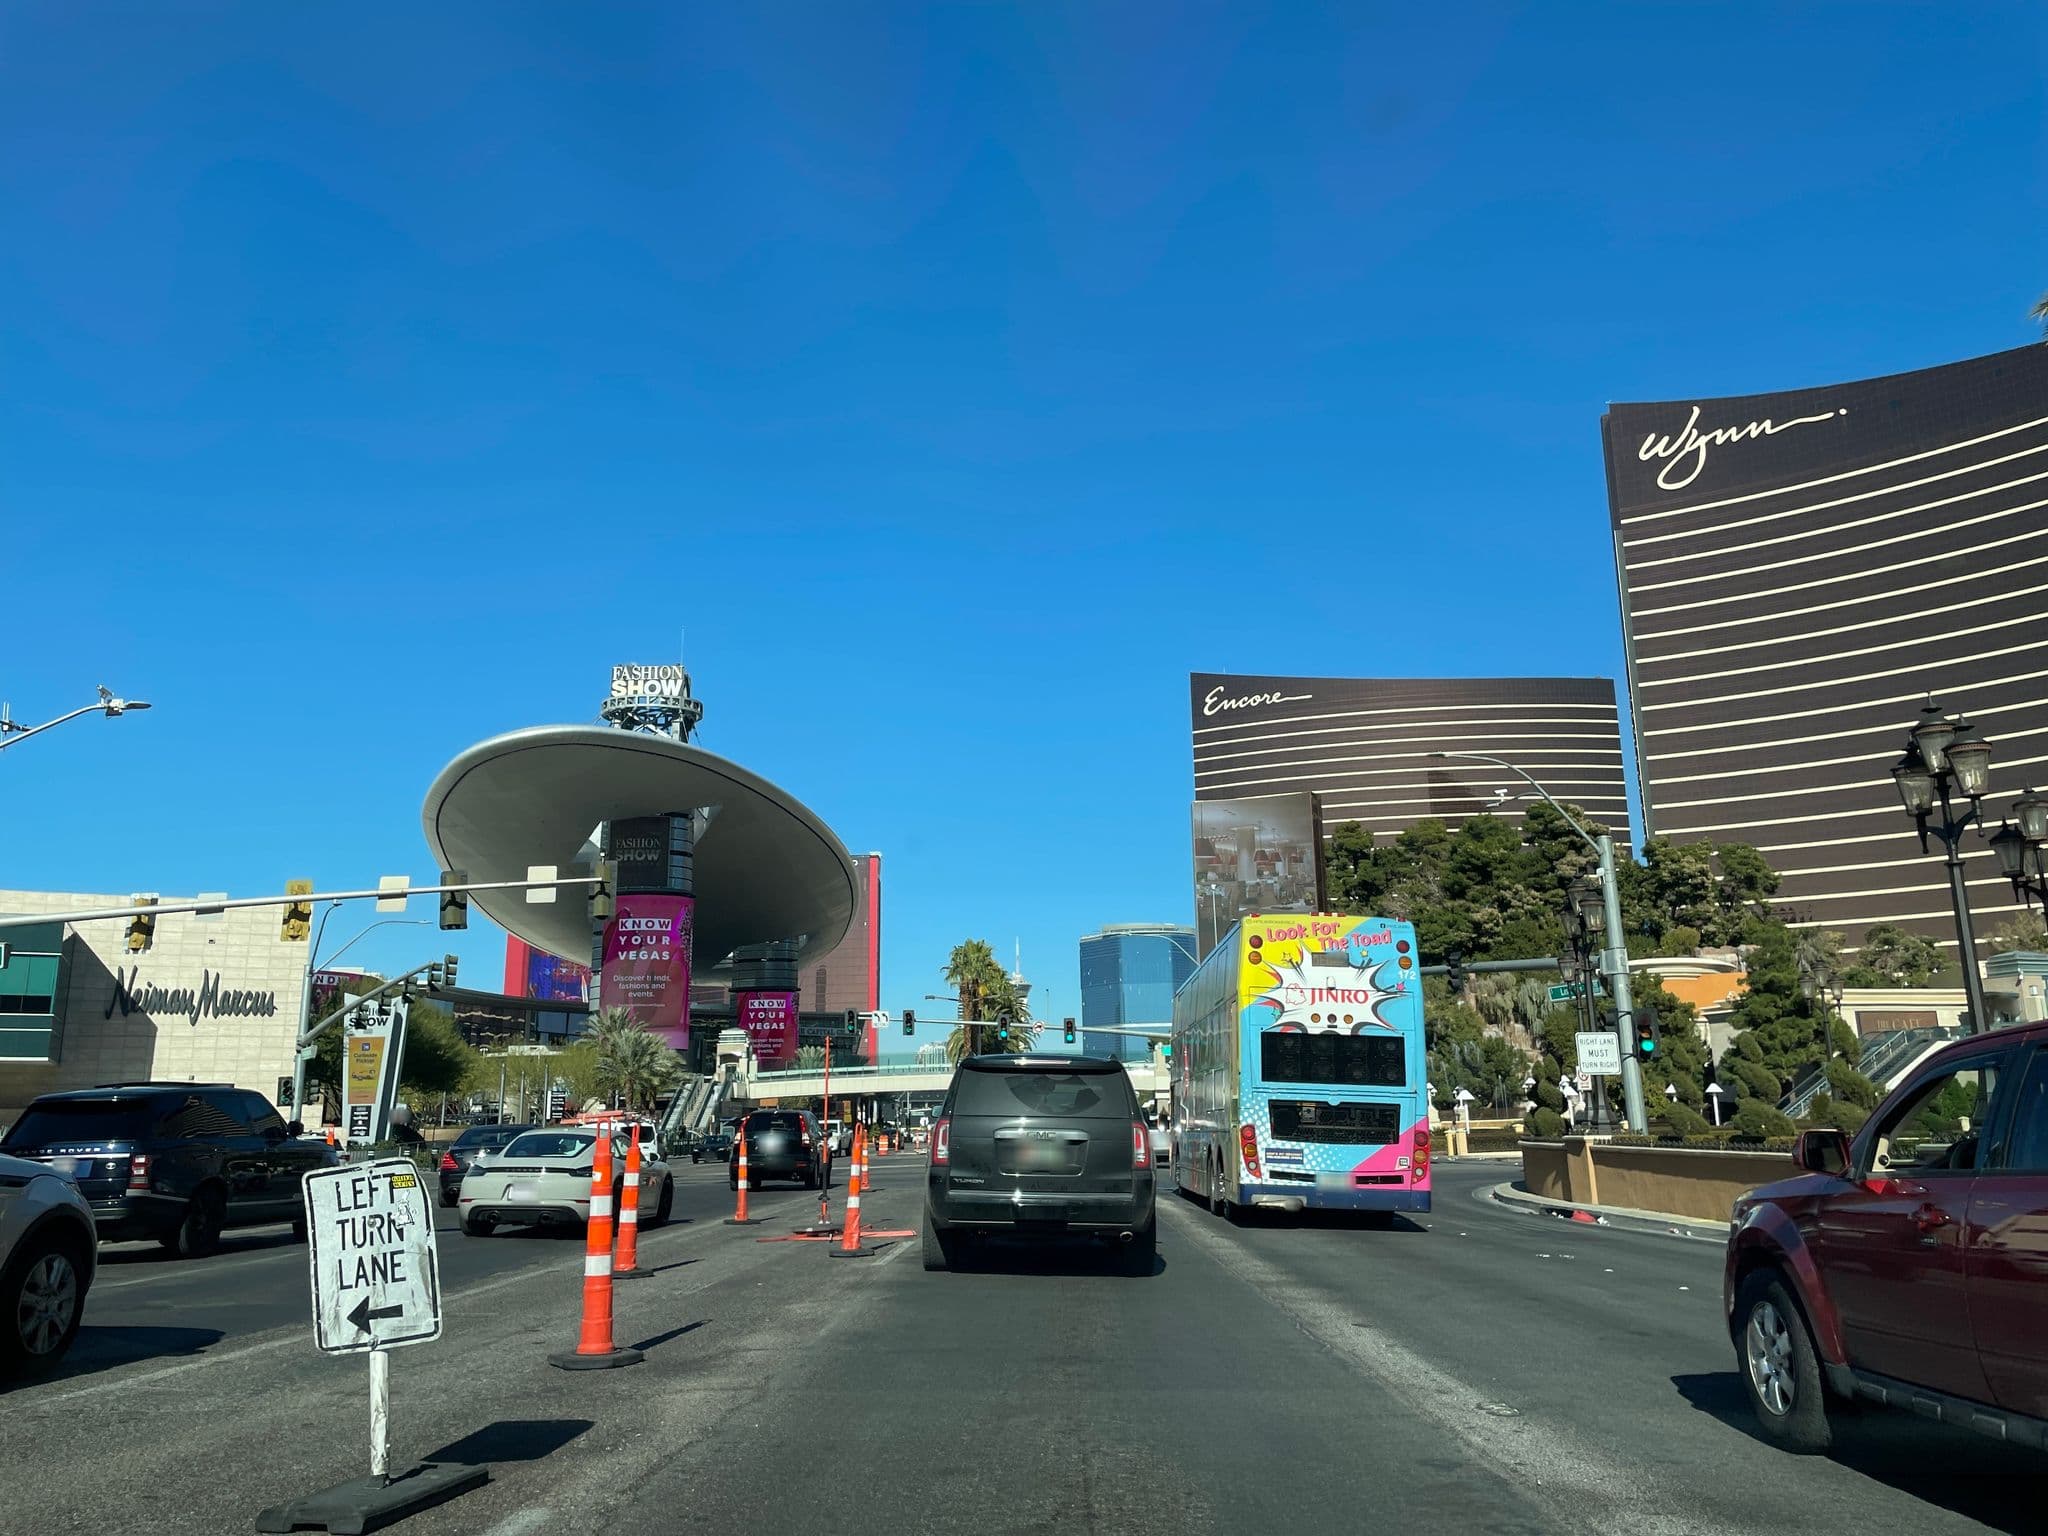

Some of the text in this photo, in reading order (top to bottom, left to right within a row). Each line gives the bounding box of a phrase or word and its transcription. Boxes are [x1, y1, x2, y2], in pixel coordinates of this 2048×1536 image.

[613, 665, 683, 680] FASHION
[611, 679, 683, 697] SHOW
[1203, 685, 1312, 716] Encore
[616, 837, 661, 849] FASHION
[616, 849, 660, 861] SHOW
[620, 919, 671, 930] KNOW
[1267, 922, 1340, 943] Look For
[619, 935, 671, 946] YOUR
[1319, 930, 1392, 951] The Toad
[618, 950, 671, 960] VEGAS
[613, 974, 645, 982] Discover
[619, 982, 666, 990] fashions and
[105, 965, 278, 1027] Neiman Marcus
[1309, 987, 1369, 1006] JINRO
[750, 1000, 786, 1008] KNOW
[349, 1017, 389, 1027] SOW
[749, 1022, 785, 1030] VEGAS
[1588, 1049, 1609, 1058] MUST
[1581, 1061, 1617, 1069] TURN RIGHT
[1026, 1131, 1056, 1139] GMC
[335, 1173, 396, 1212] LEFT
[336, 1212, 405, 1251] TURN
[338, 1250, 407, 1290] LANE
